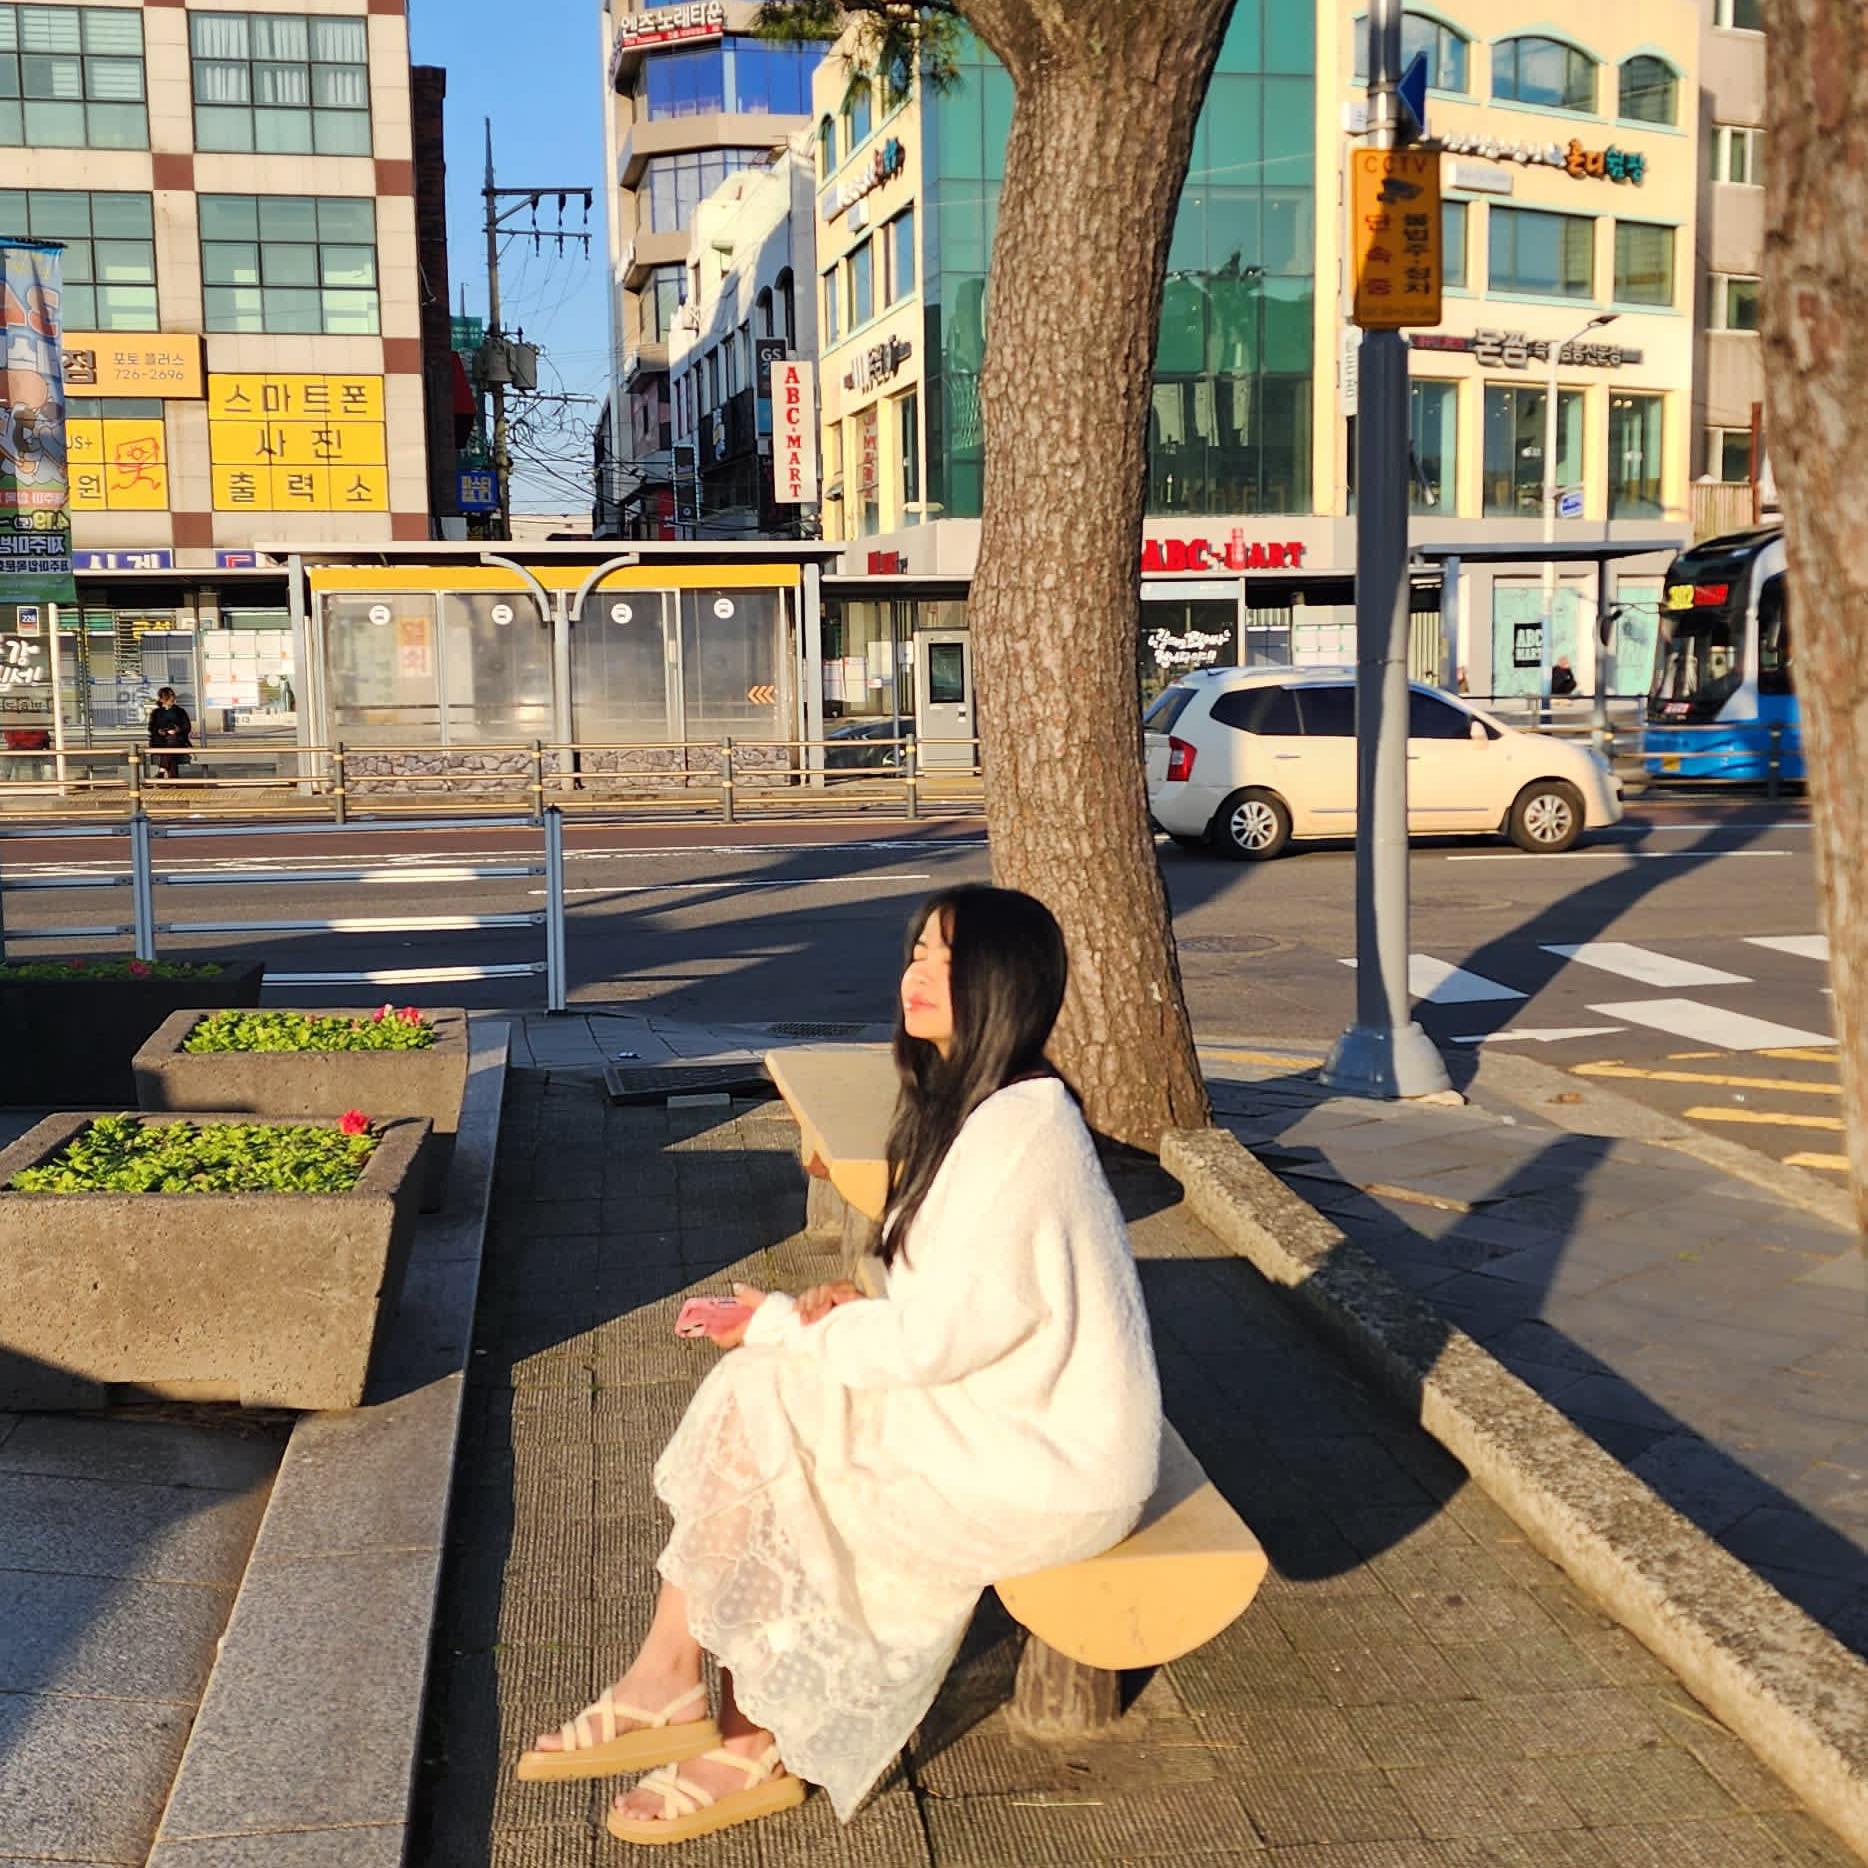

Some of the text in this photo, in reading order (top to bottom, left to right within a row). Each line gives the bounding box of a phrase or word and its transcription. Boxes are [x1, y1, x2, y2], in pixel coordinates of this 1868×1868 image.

[1364, 155, 1428, 174] CCTV
[113, 352, 139, 366] 포토
[761, 348, 782, 361] GS
[114, 369, 184, 381] 726-2696
[224, 384, 369, 414] 스마트폰
[228, 472, 373, 503] 출력소
